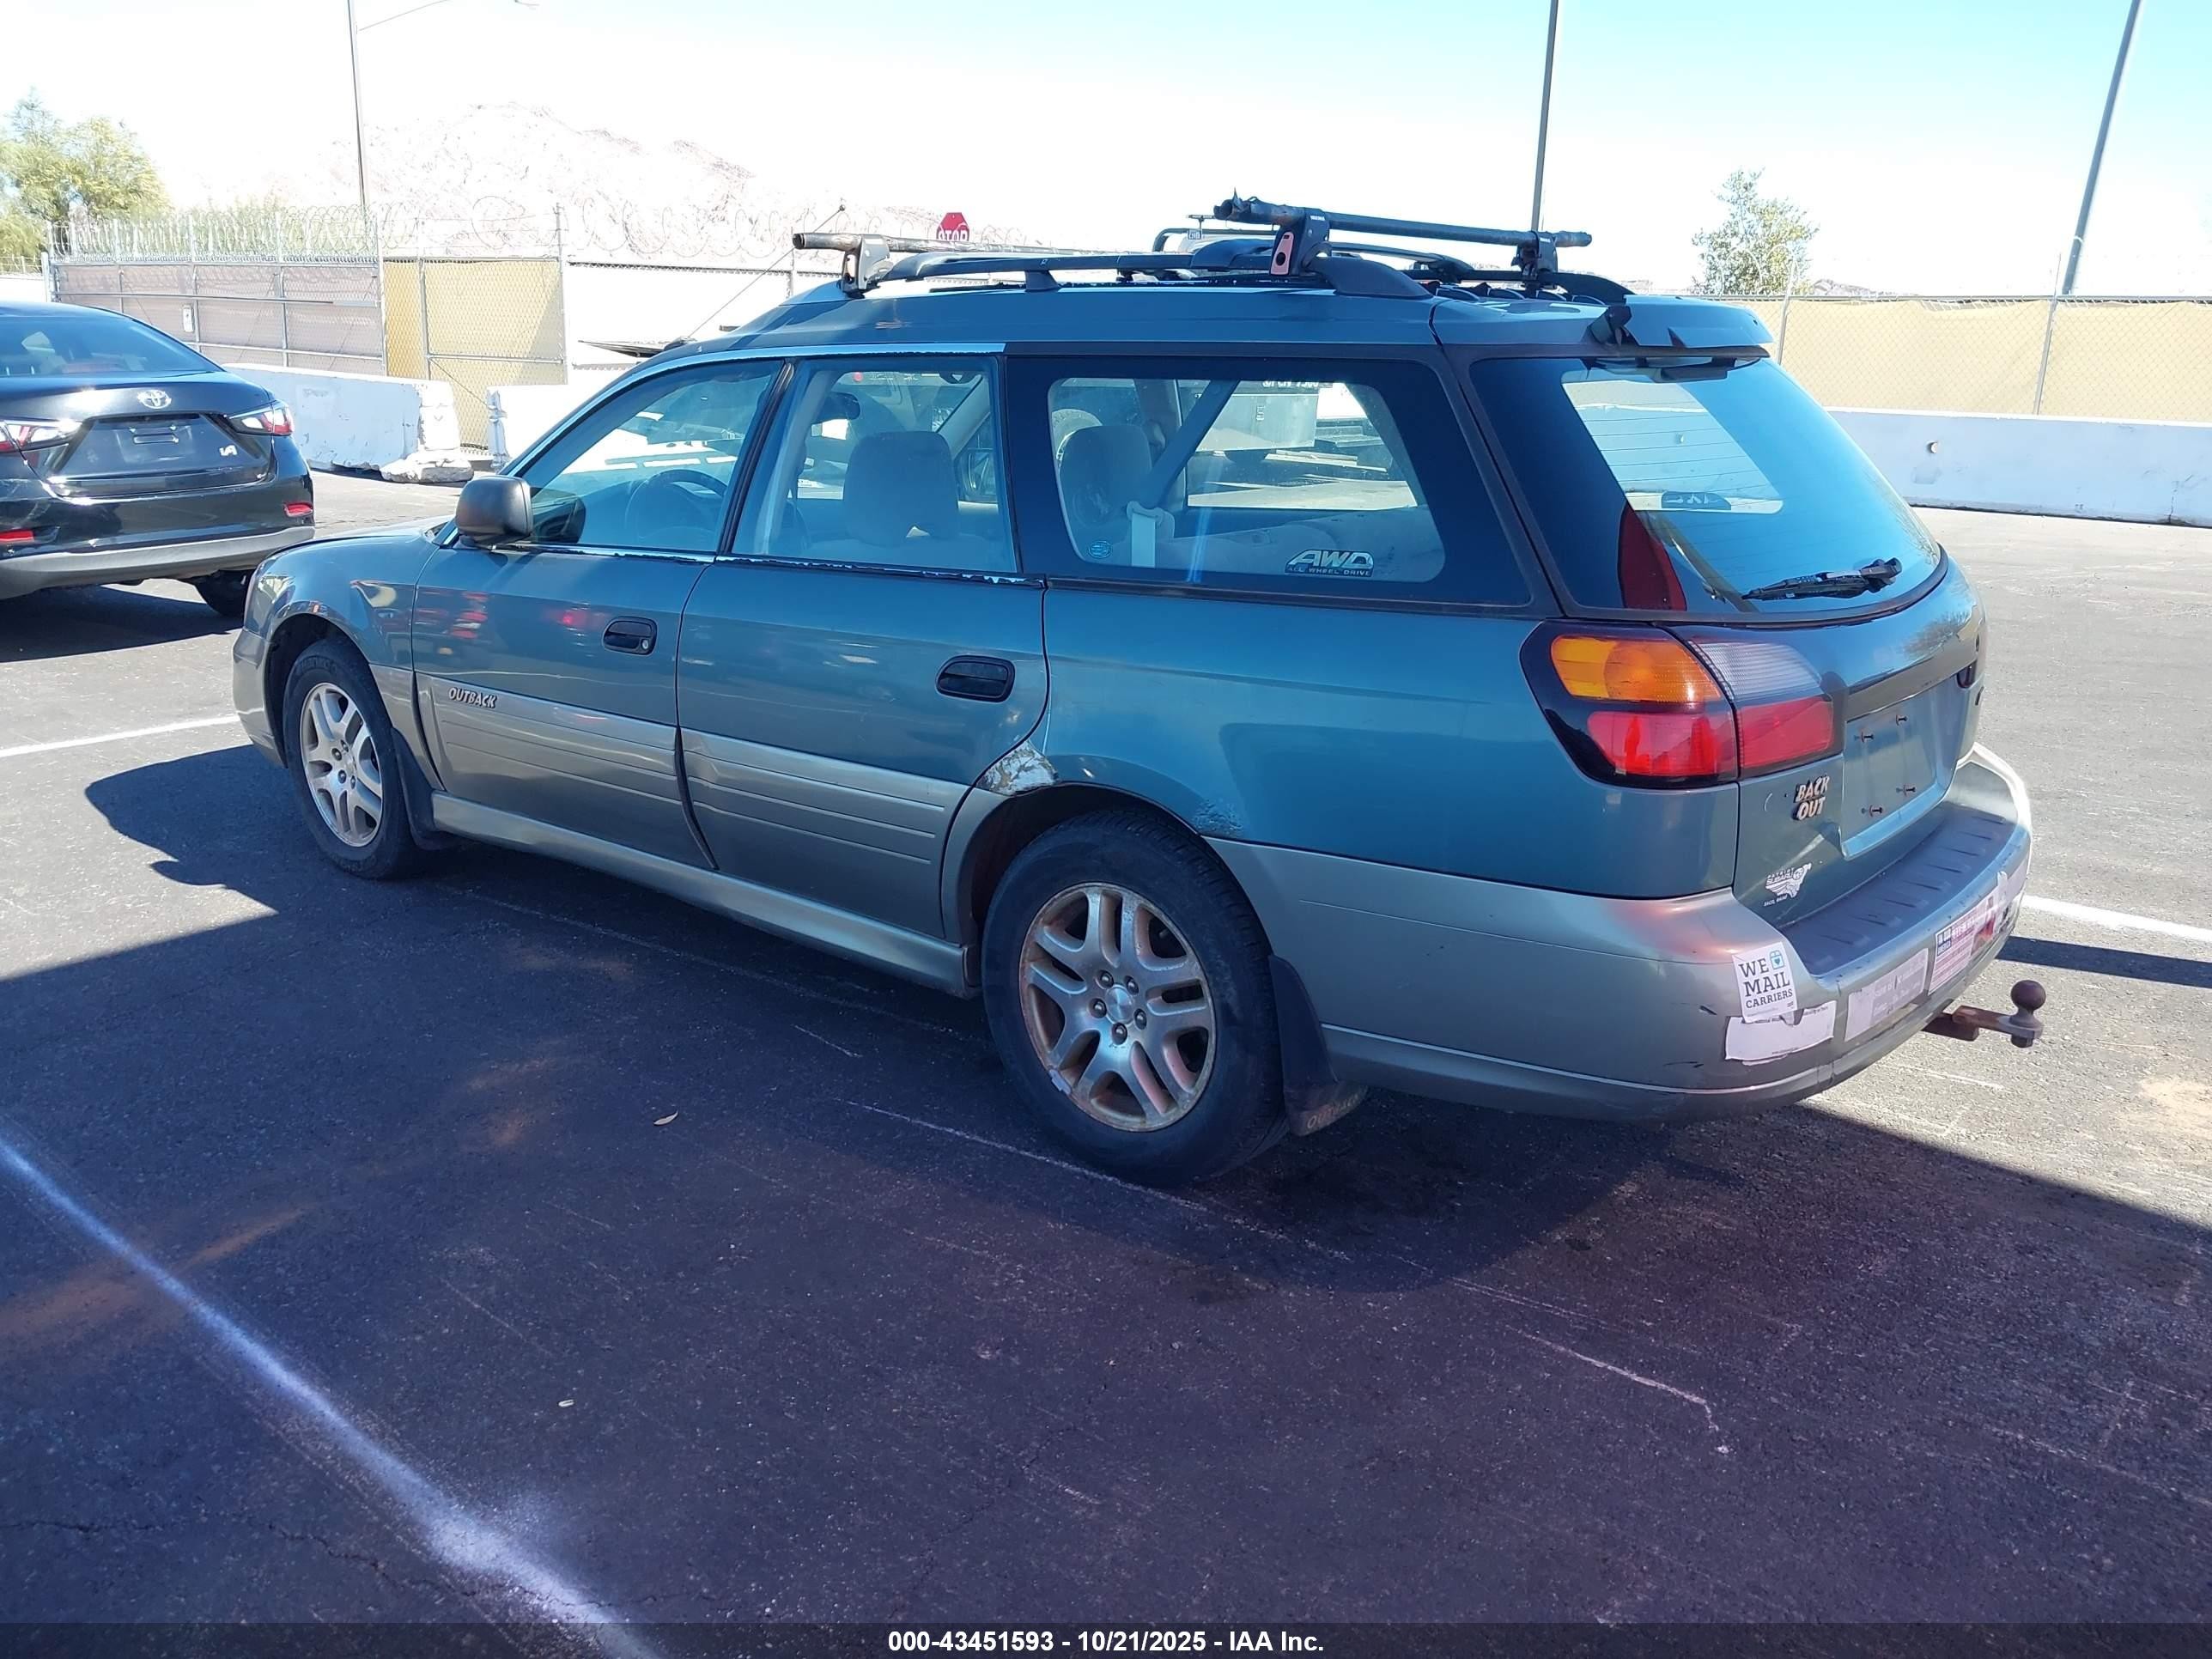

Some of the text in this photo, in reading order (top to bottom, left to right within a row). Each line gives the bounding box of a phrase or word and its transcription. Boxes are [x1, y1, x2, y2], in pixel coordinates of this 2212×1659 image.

[1287, 550, 1374, 569] AWD
[448, 687, 497, 708] OUTBACK
[1795, 775, 1830, 802] BACK
[1796, 796, 1826, 821] OUT
[1765, 872, 1793, 886] SUBARU
[1738, 957, 1770, 978] WE
[1743, 971, 1791, 998] MAIL
[1745, 988, 1794, 1009] CARRIERS
